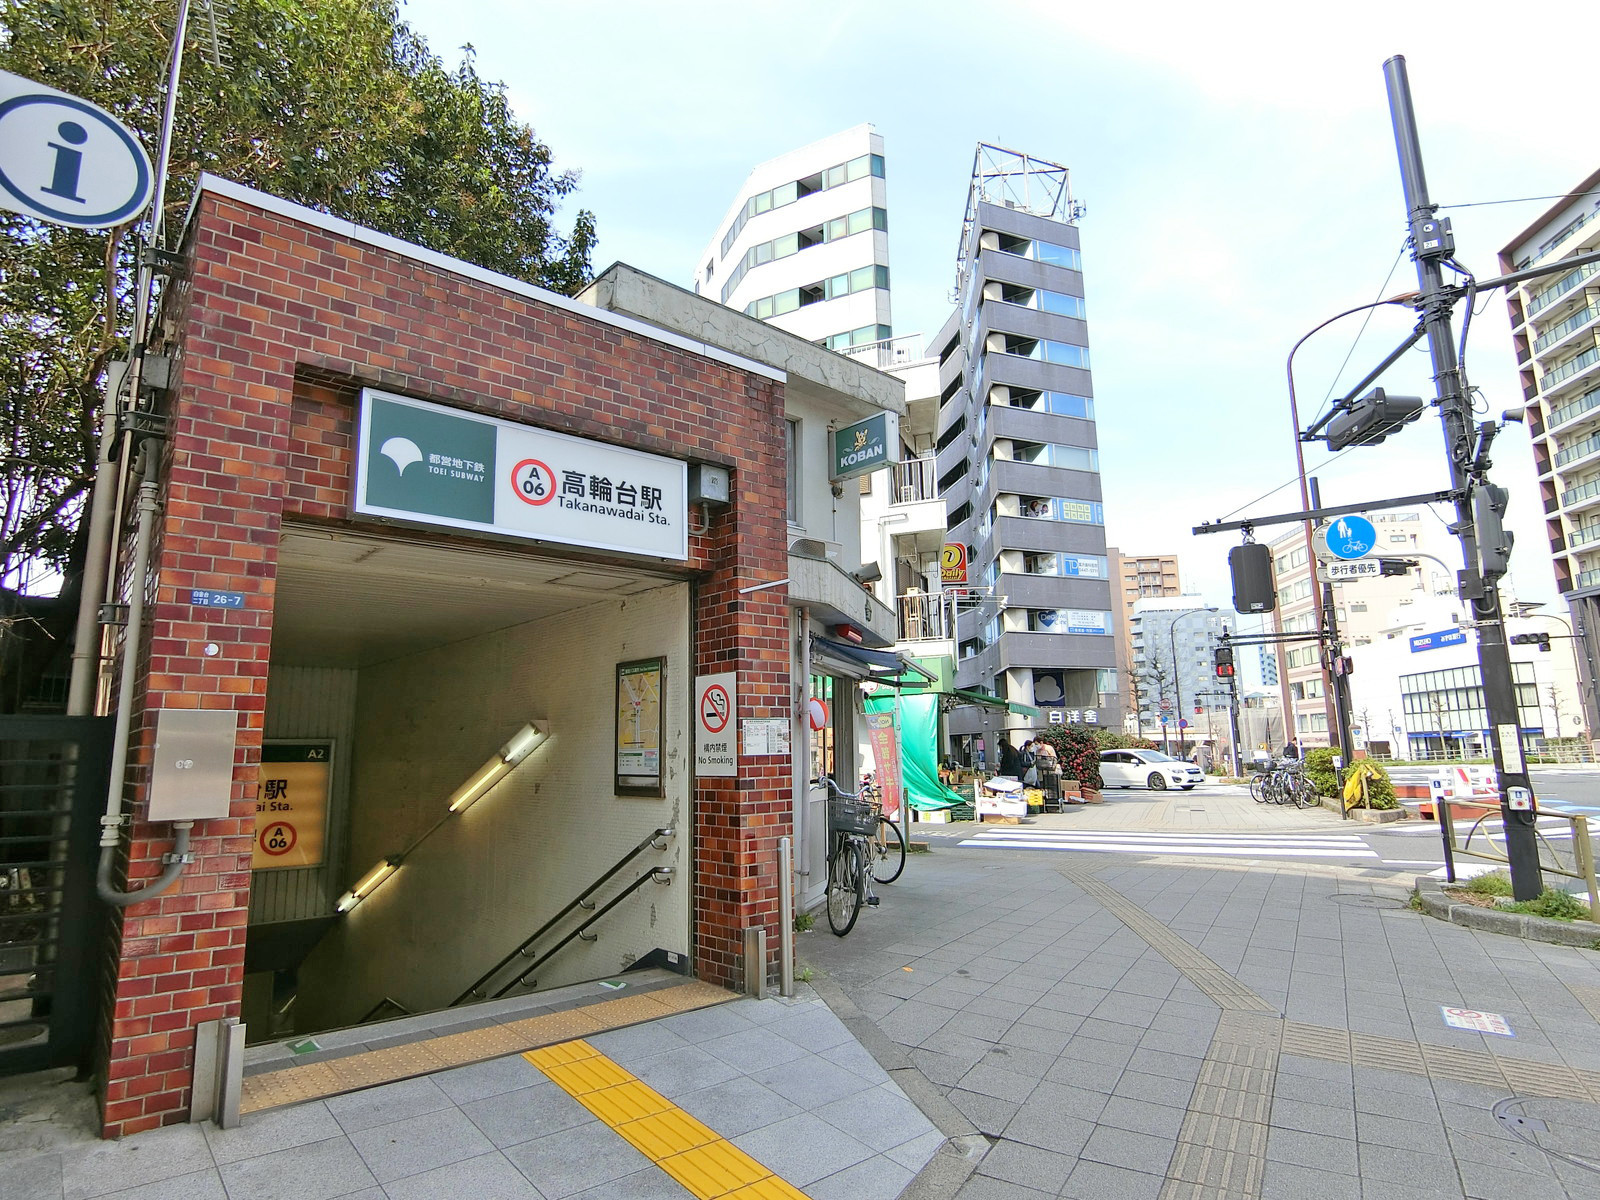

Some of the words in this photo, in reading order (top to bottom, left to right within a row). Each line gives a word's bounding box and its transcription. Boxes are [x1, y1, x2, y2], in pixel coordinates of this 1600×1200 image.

[841, 444, 883, 467] KOBAN
[429, 454, 485, 473] 都営地下鉄
[428, 466, 447, 475] TOEI
[450, 470, 485, 482] SUBWAY
[528, 467, 541, 480] A
[523, 480, 545, 496] 06
[562, 470, 663, 511] 高輪台駅
[557, 495, 645, 521] Takanawadai
[648, 512, 671, 526] Sta.
[1331, 562, 1377, 576] 歩行者優先
[213, 594, 242, 606] 26-7
[307, 749, 325, 759] A2
[704, 742, 728, 753] 構内禁煙
[698, 756, 707, 764] No
[708, 755, 734, 767] Smoking
[270, 802, 294, 812] Sta.
[273, 827, 284, 837] A
[269, 838, 288, 849] 06
